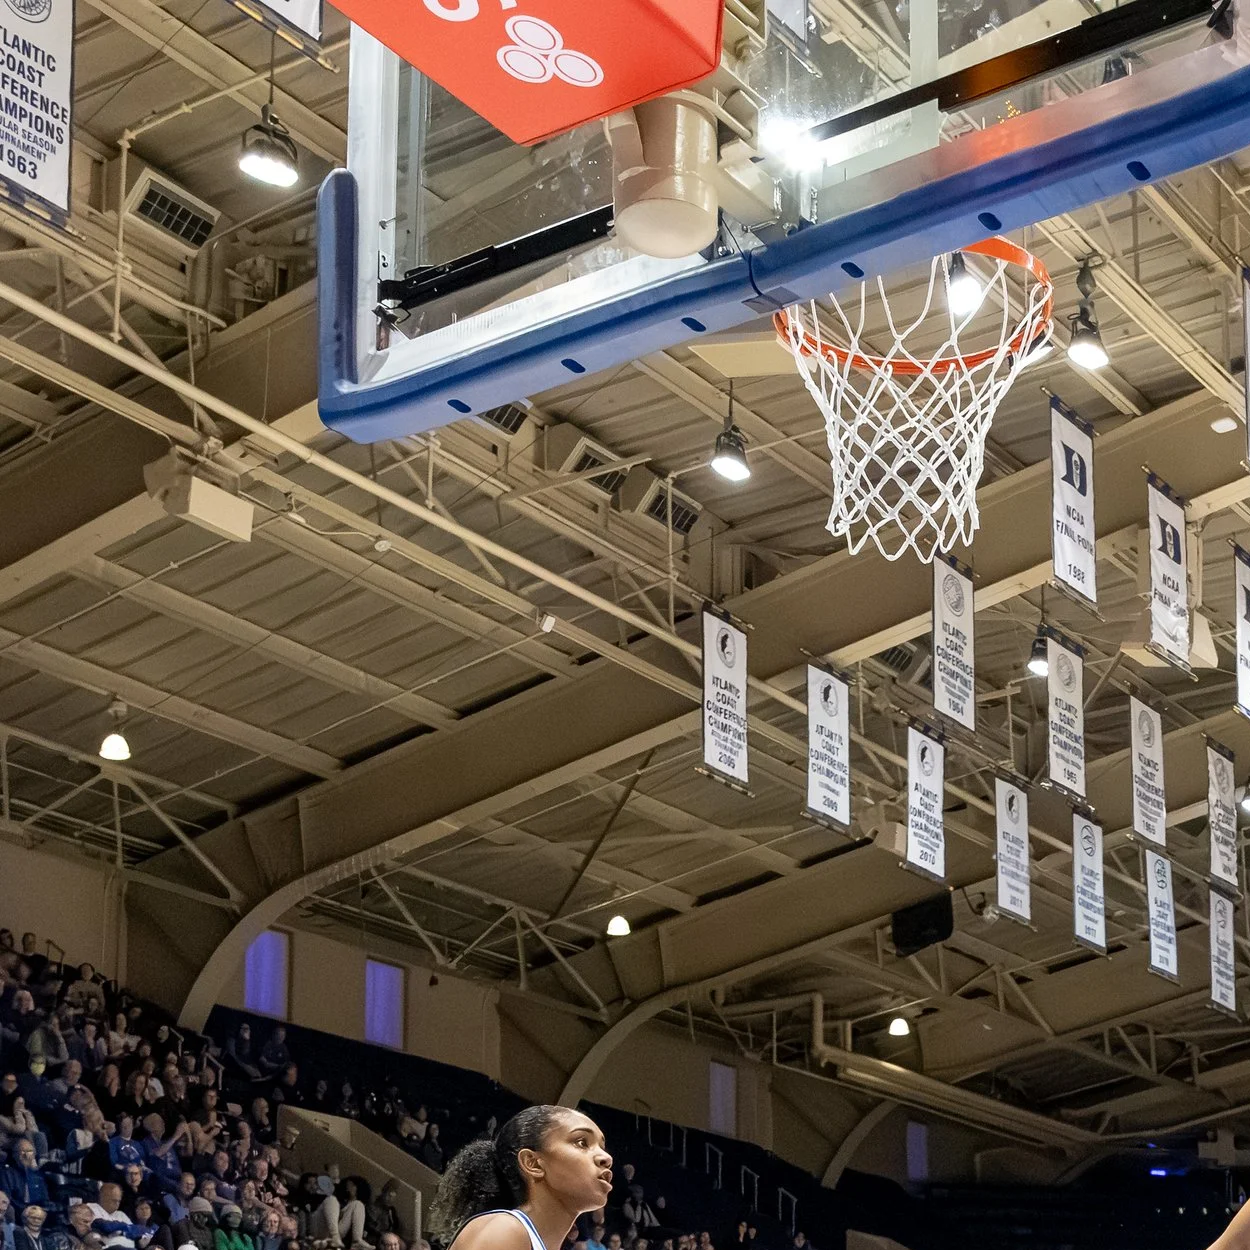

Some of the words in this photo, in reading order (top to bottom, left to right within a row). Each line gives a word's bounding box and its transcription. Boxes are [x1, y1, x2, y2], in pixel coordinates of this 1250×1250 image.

[0, 72, 69, 126] FERENCE
[21, 123, 57, 156] SEASON
[0, 146, 37, 181] 1963
[1066, 504, 1086, 529] NCAA
